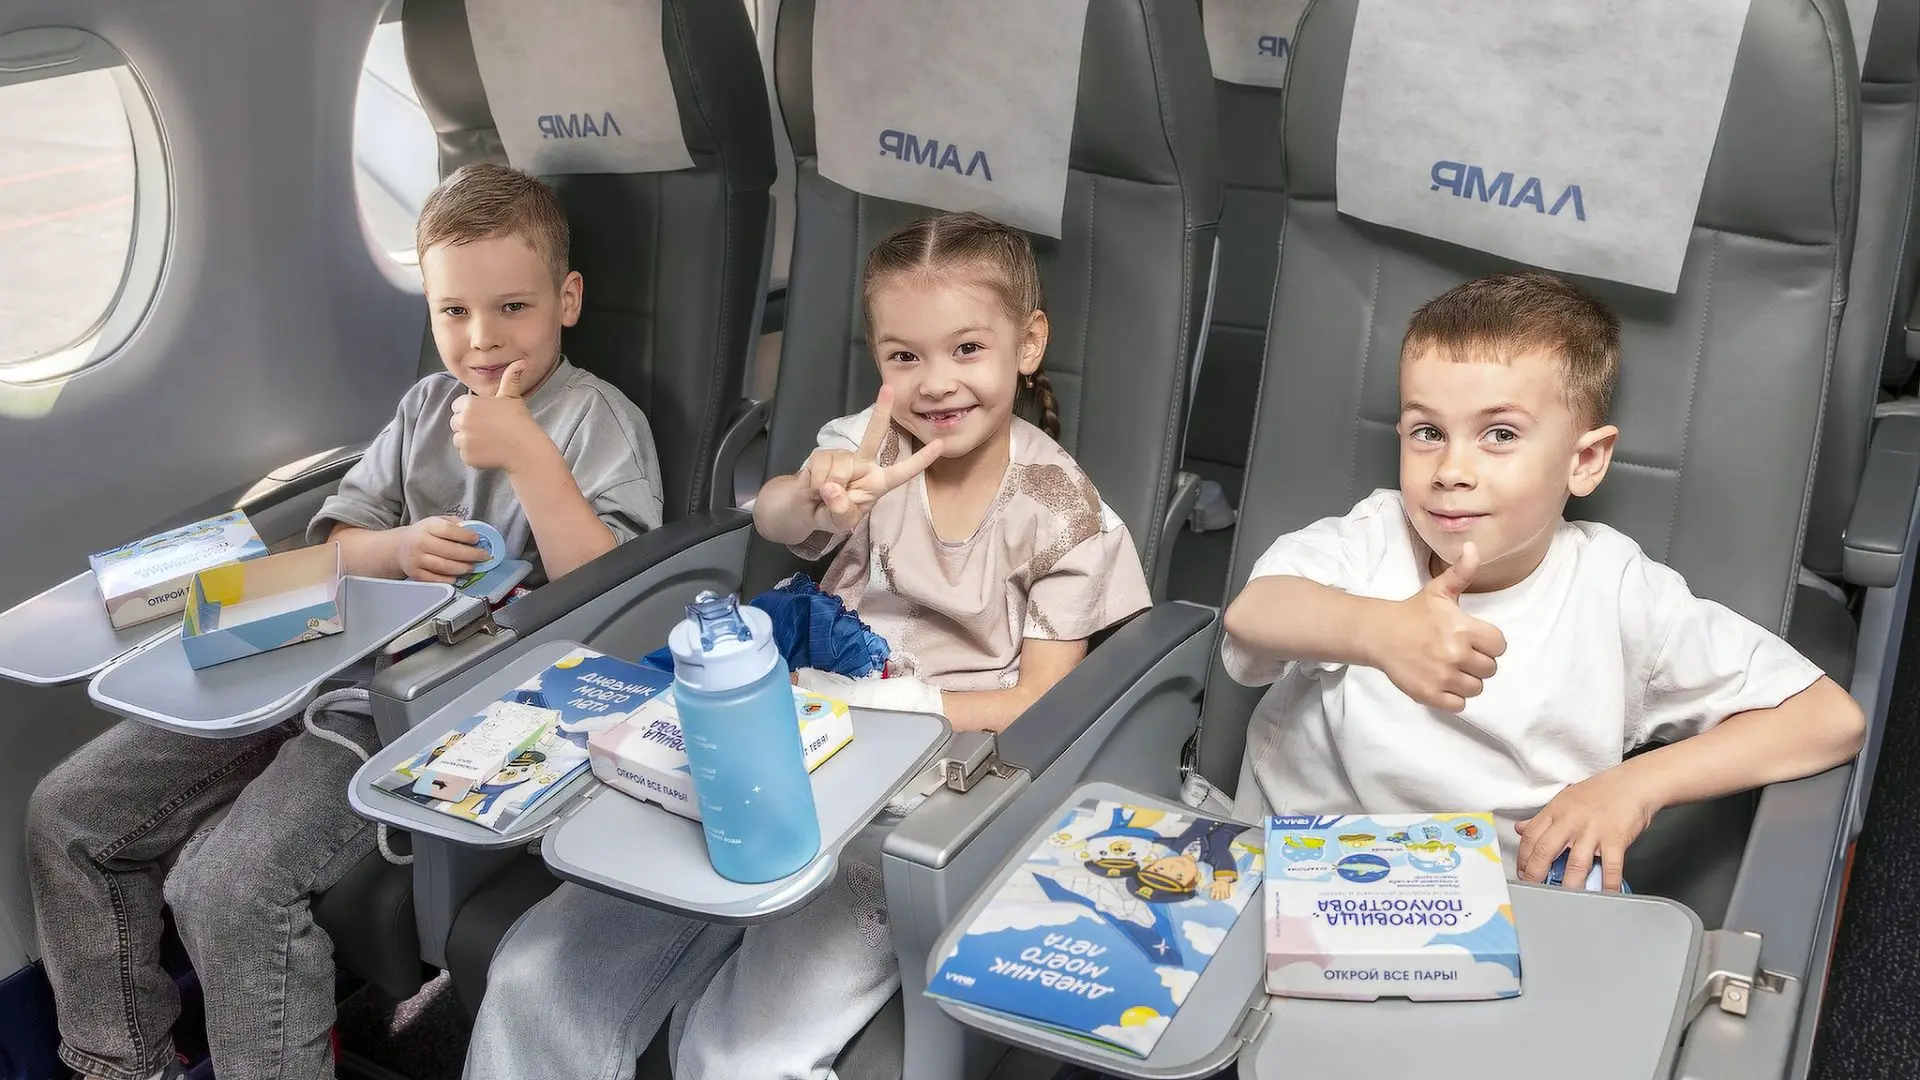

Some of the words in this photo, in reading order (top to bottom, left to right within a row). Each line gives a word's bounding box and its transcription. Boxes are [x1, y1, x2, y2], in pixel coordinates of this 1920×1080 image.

[538, 112, 622, 138] ЯМАЛ
[879, 130, 992, 181] ЯМАЛ
[1430, 160, 1586, 221] ЯМАЛ
[148, 588, 185, 606] ОТКРОЙ
[616, 767, 645, 786] ОТКРОЙ
[647, 780, 661, 792] ВСЕ
[1324, 968, 1379, 981] ОТКРОЙ
[1384, 970, 1410, 981] ВСЕ
[1414, 970, 1458, 981] ПАРЫ!
